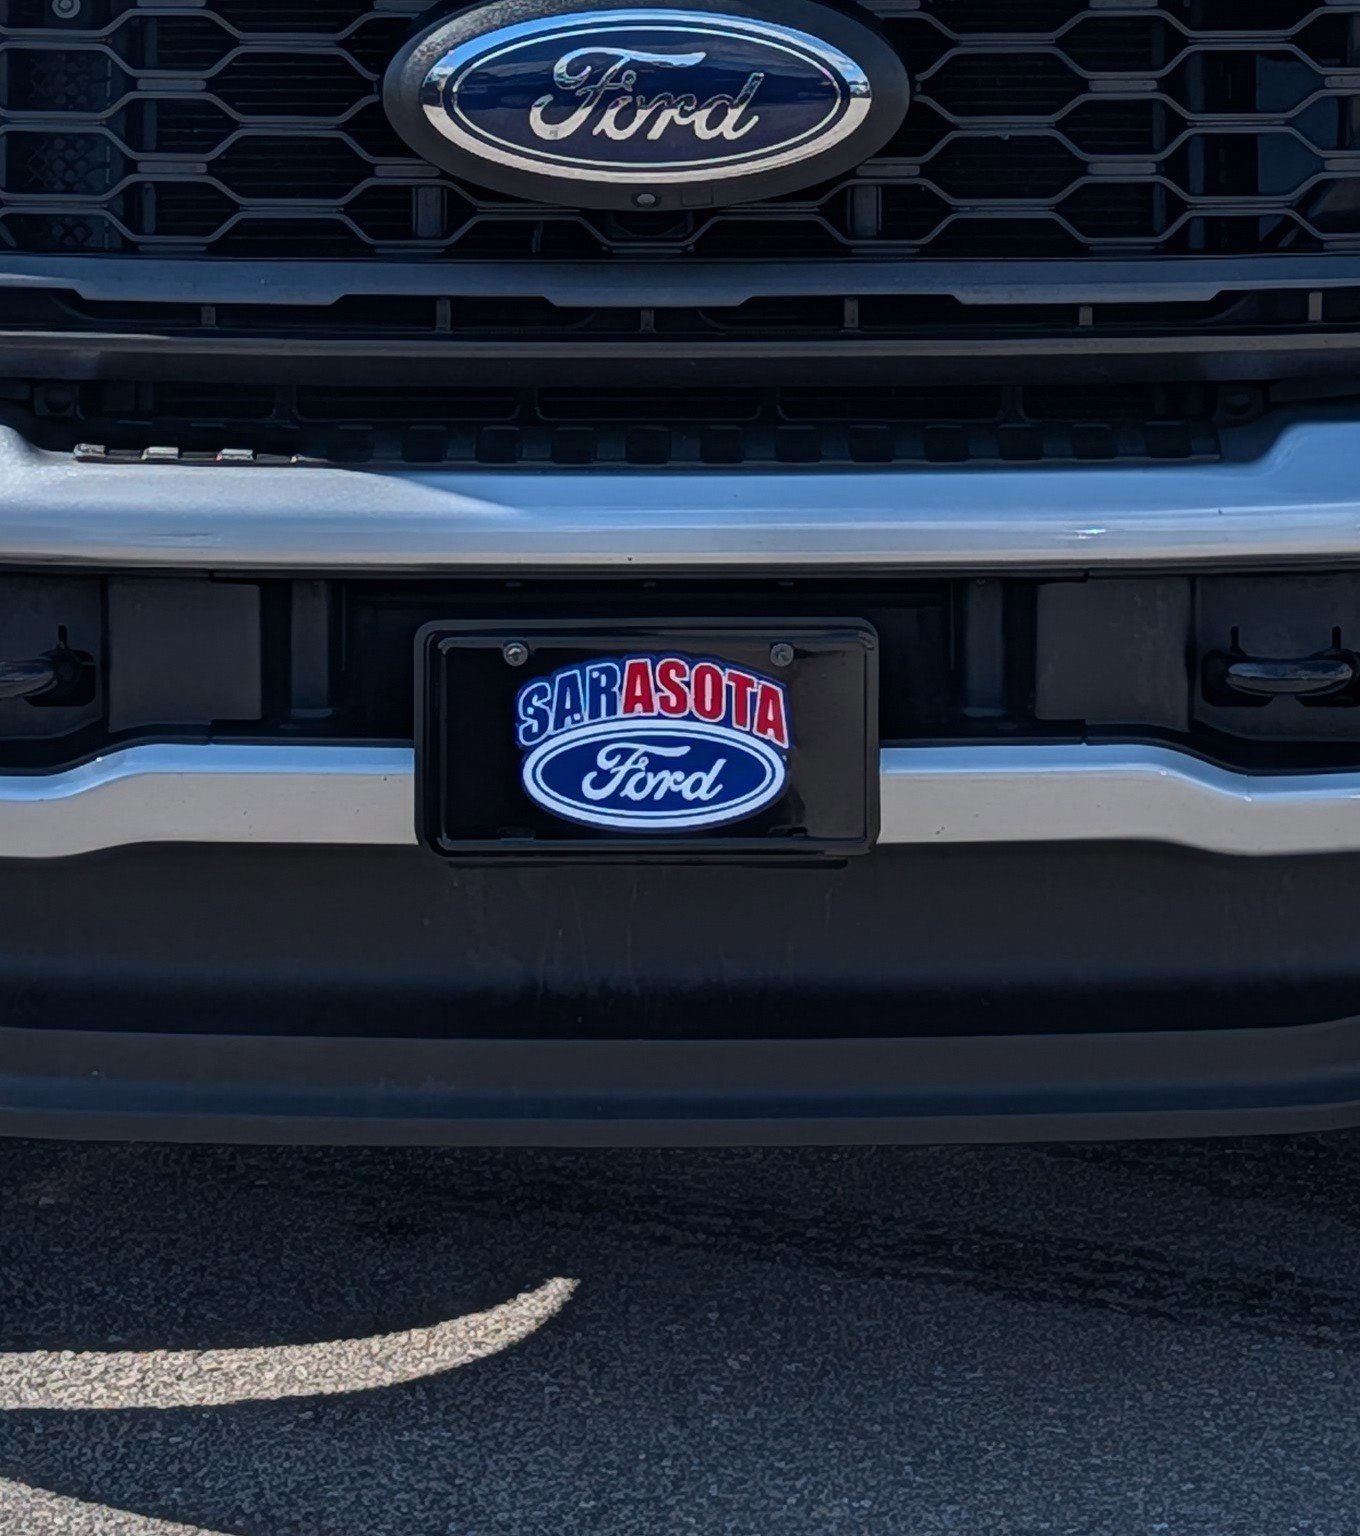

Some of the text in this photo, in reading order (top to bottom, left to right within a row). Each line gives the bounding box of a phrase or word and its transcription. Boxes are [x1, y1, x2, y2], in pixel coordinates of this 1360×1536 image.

[527, 46, 765, 142] Ford
[516, 656, 791, 750] SARASOTA
[581, 741, 729, 802] Ford
